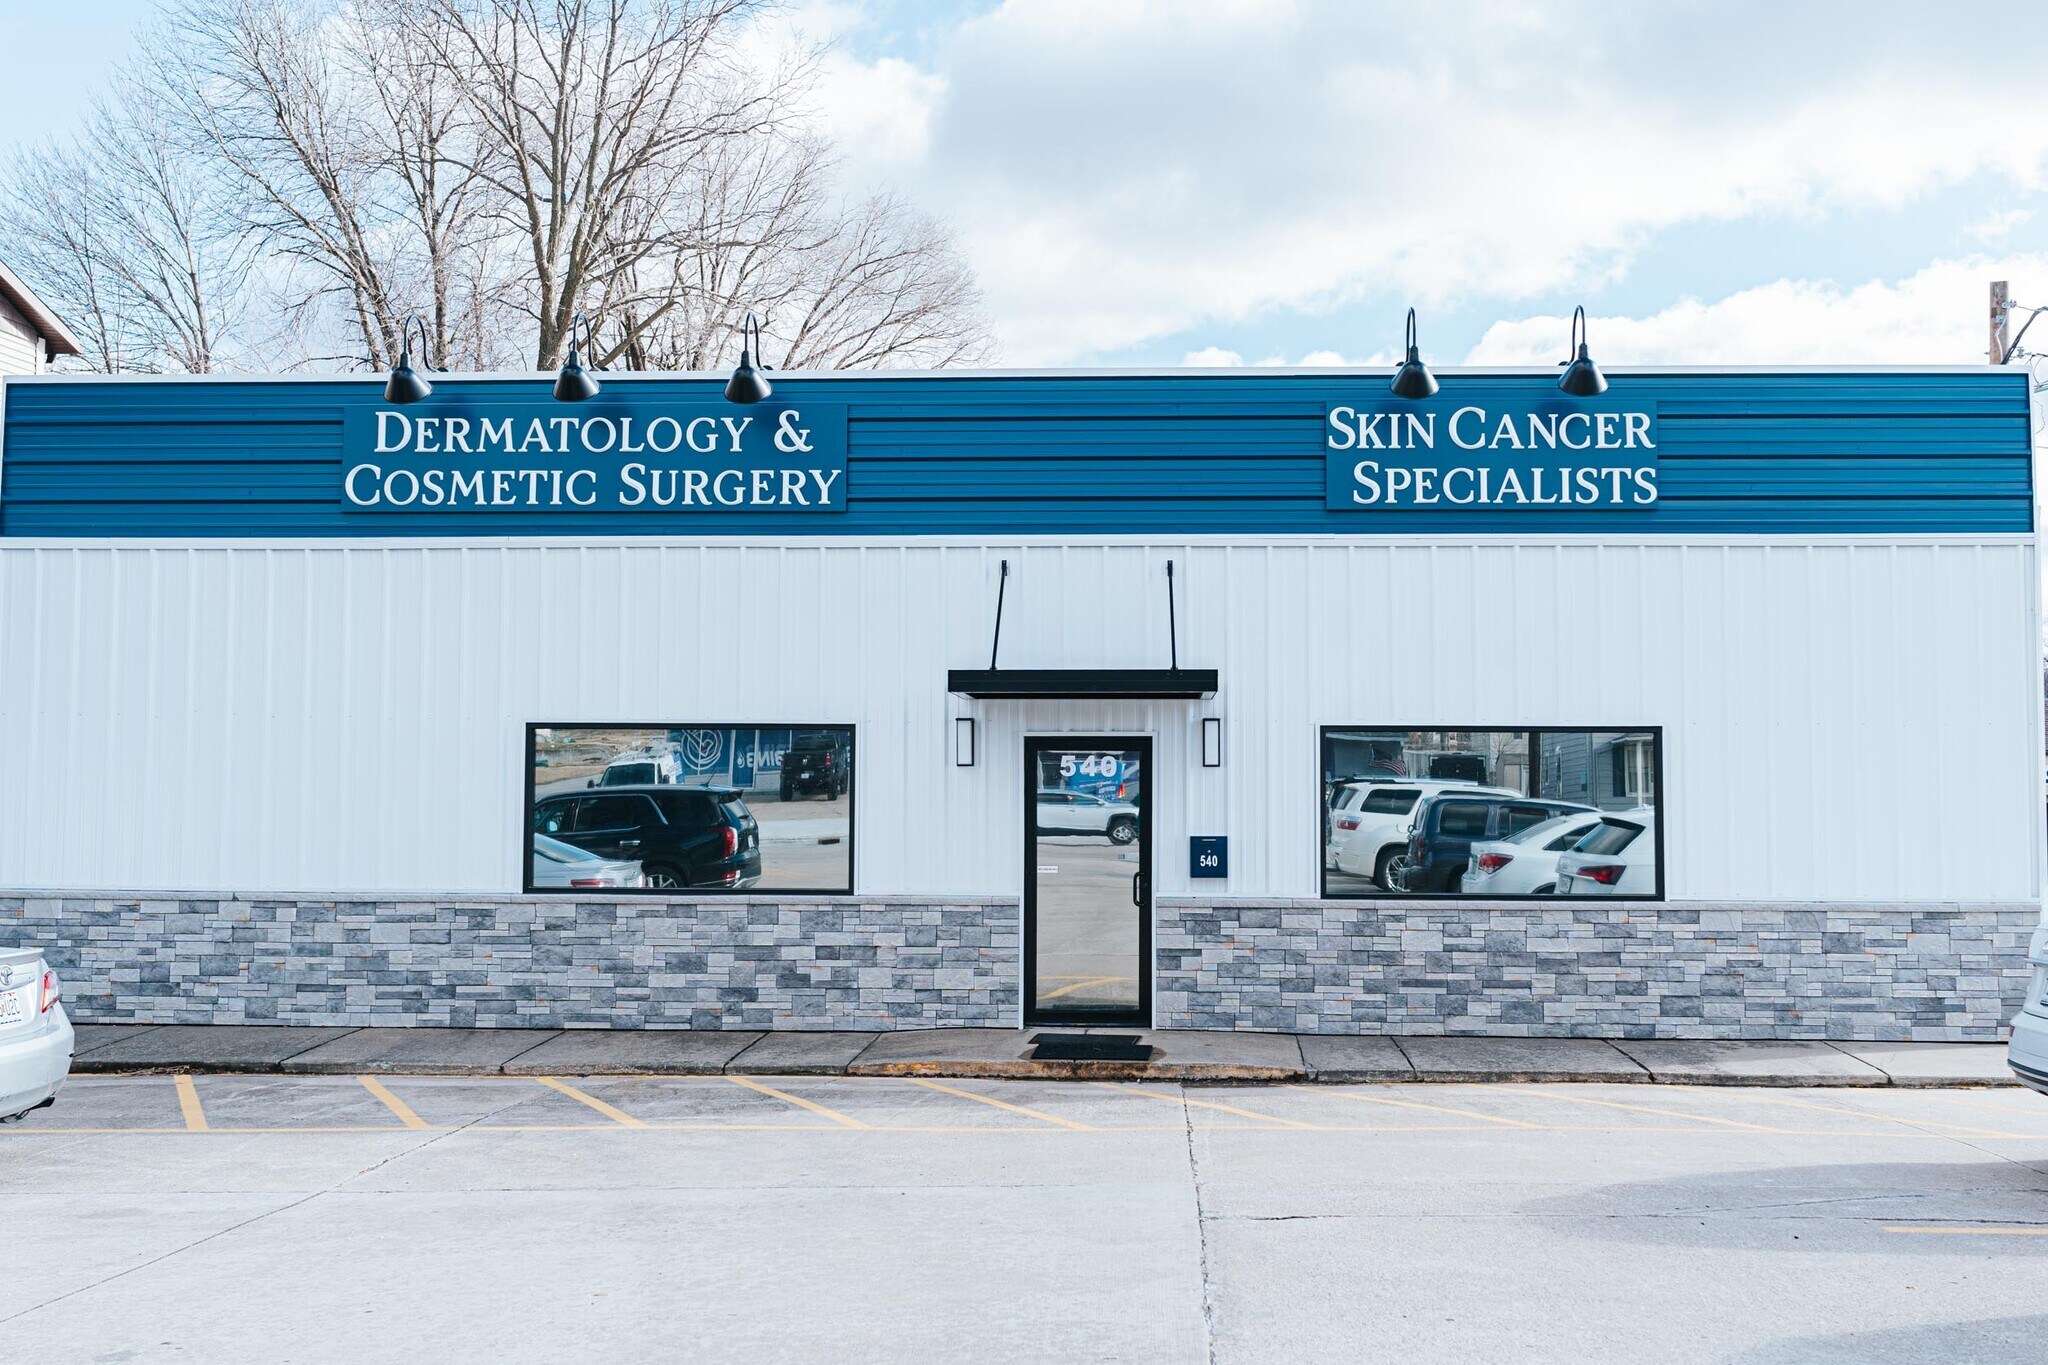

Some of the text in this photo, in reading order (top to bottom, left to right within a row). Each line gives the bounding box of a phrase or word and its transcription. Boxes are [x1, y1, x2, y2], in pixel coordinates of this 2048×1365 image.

[375, 410, 813, 452] DERMATOLOGY &
[1329, 407, 1655, 449] SKIN CANCER
[345, 463, 841, 505] COSMETIC SURGERY
[1354, 461, 1657, 503] SPECIALISTS
[1060, 755, 1117, 777] 540
[1200, 855, 1218, 867] 540
